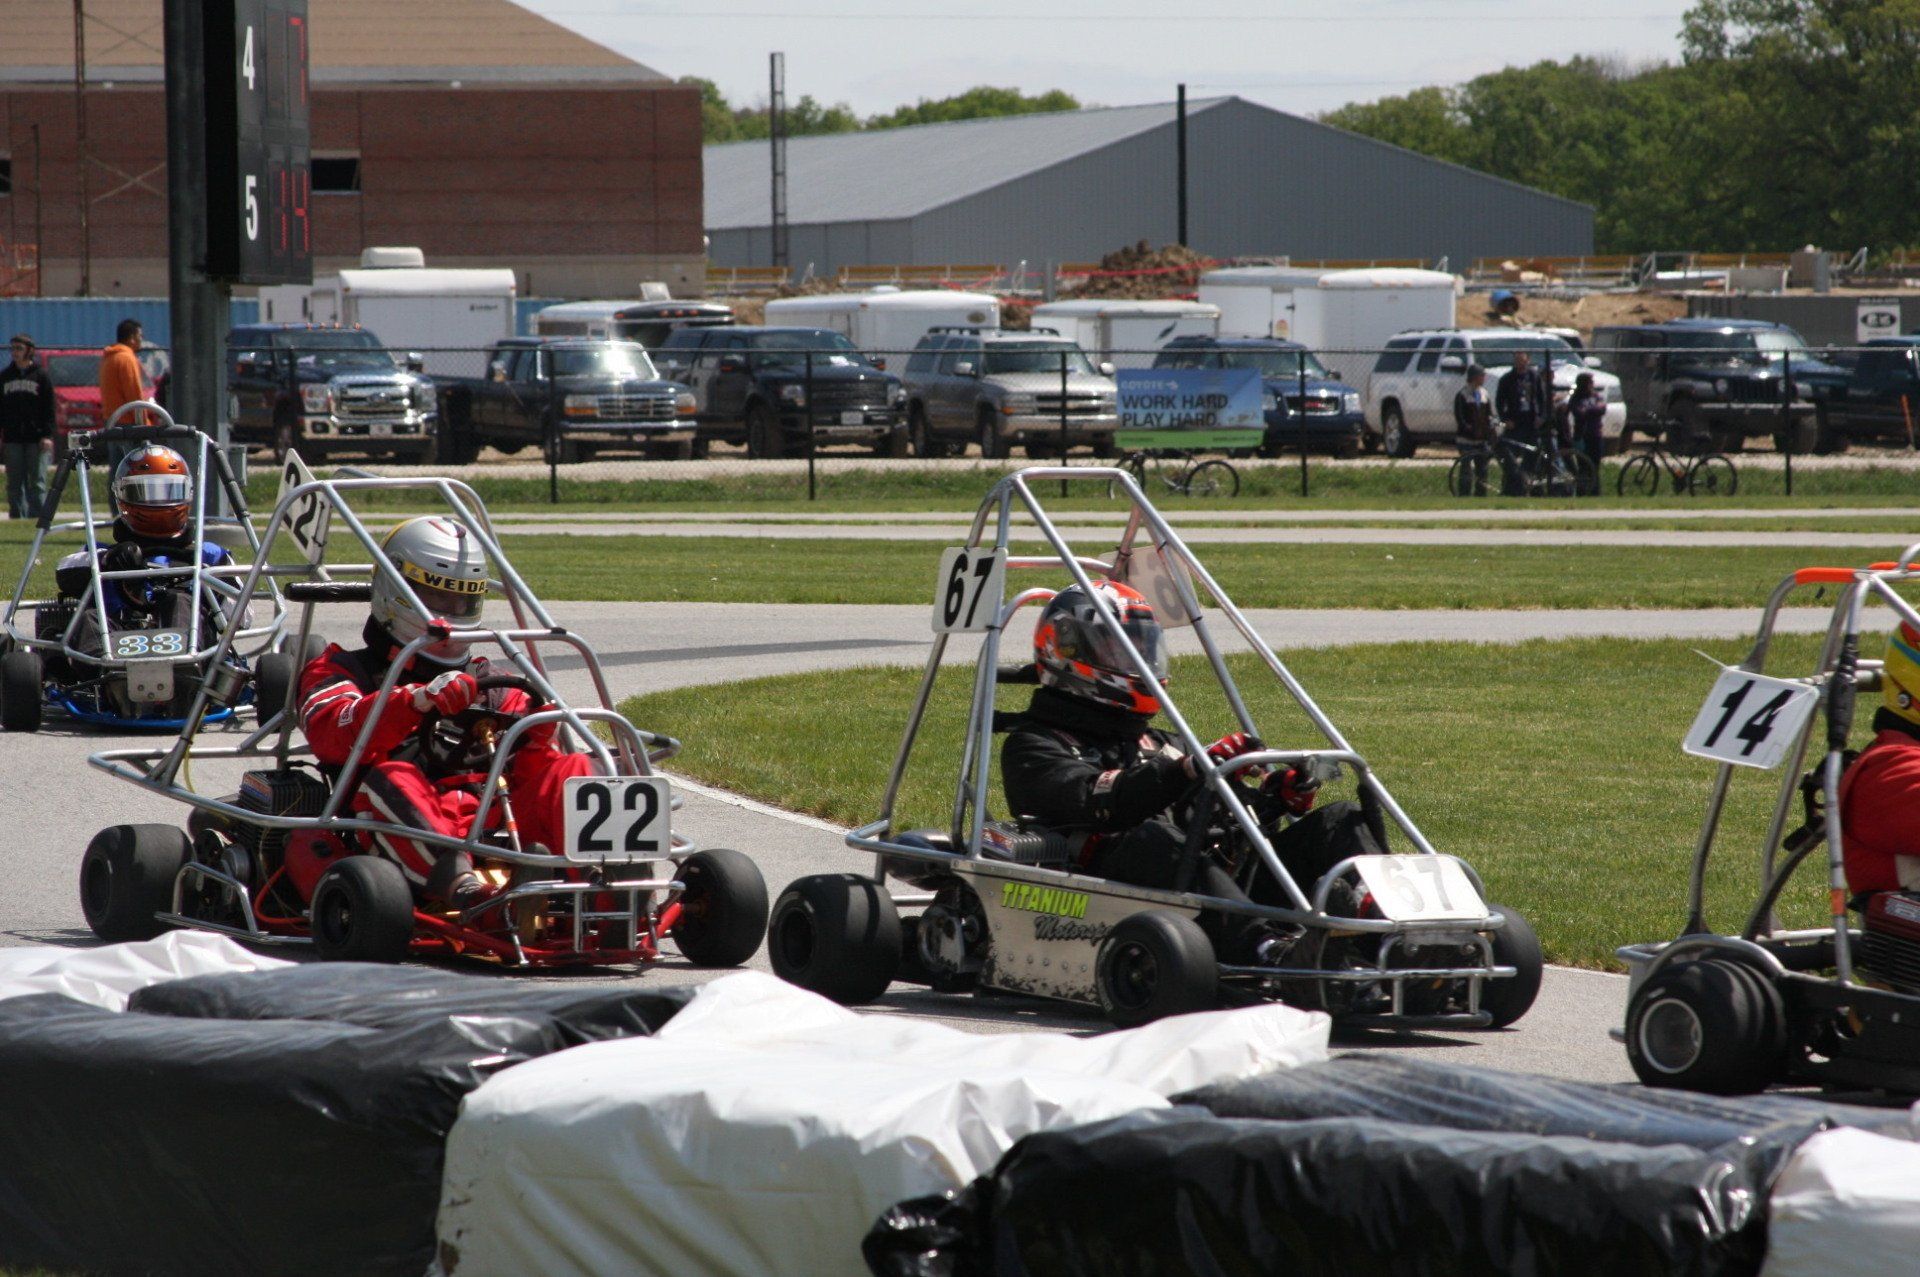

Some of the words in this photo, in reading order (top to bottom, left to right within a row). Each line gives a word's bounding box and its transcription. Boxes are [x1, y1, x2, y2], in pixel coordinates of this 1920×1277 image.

[242, 25, 255, 90] 4
[245, 175, 258, 241] 5
[1122, 394, 1176, 410] WORK
[1122, 412, 1164, 427] PLAY
[424, 572, 489, 593] WEIDA
[944, 553, 995, 628] 67
[117, 632, 183, 656] 33
[1704, 680, 1795, 756] 14
[576, 782, 659, 852] 22
[1001, 881, 1090, 919] TITANIUM
